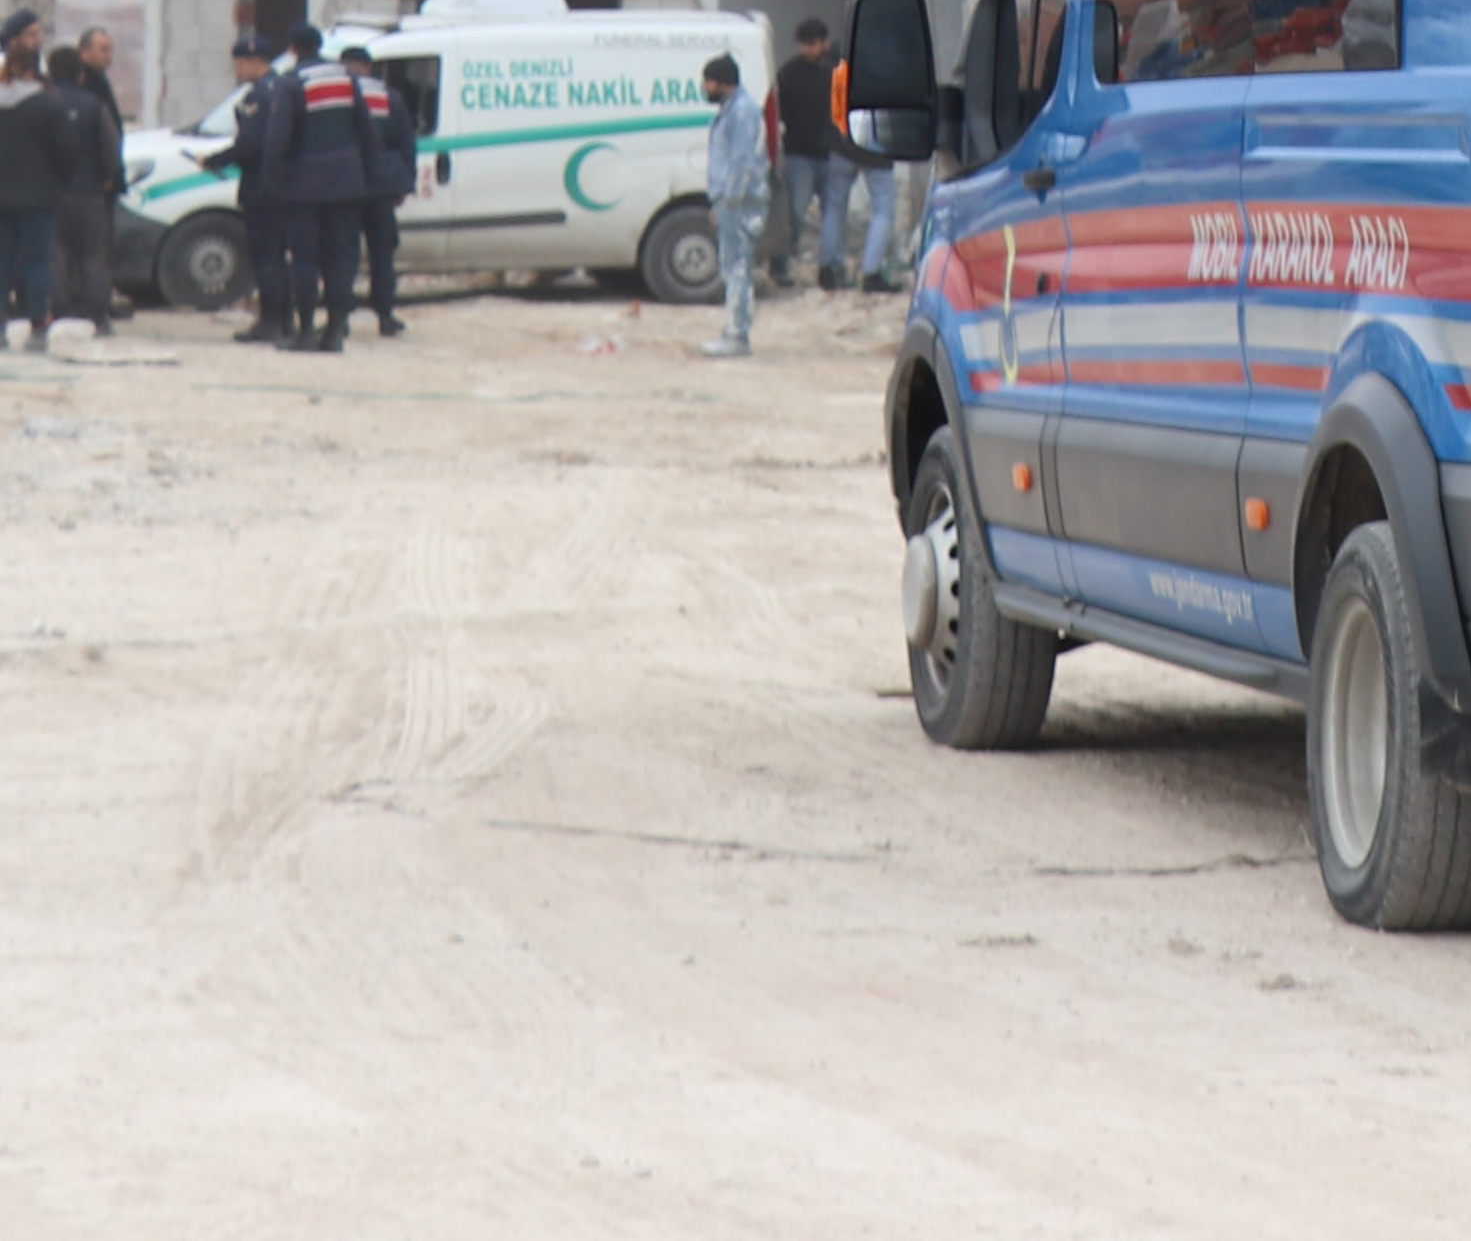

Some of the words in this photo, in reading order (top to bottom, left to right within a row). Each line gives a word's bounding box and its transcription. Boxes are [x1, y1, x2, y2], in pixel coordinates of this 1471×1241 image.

[462, 58, 503, 79] ÖZEL
[508, 56, 573, 79] DENİZLİ
[461, 81, 558, 109] CENAZE
[567, 74, 642, 107] NAKİL
[650, 77, 710, 105] ARAC
[1249, 212, 1335, 284] KARAKOL
[1345, 214, 1410, 290] ARACI
